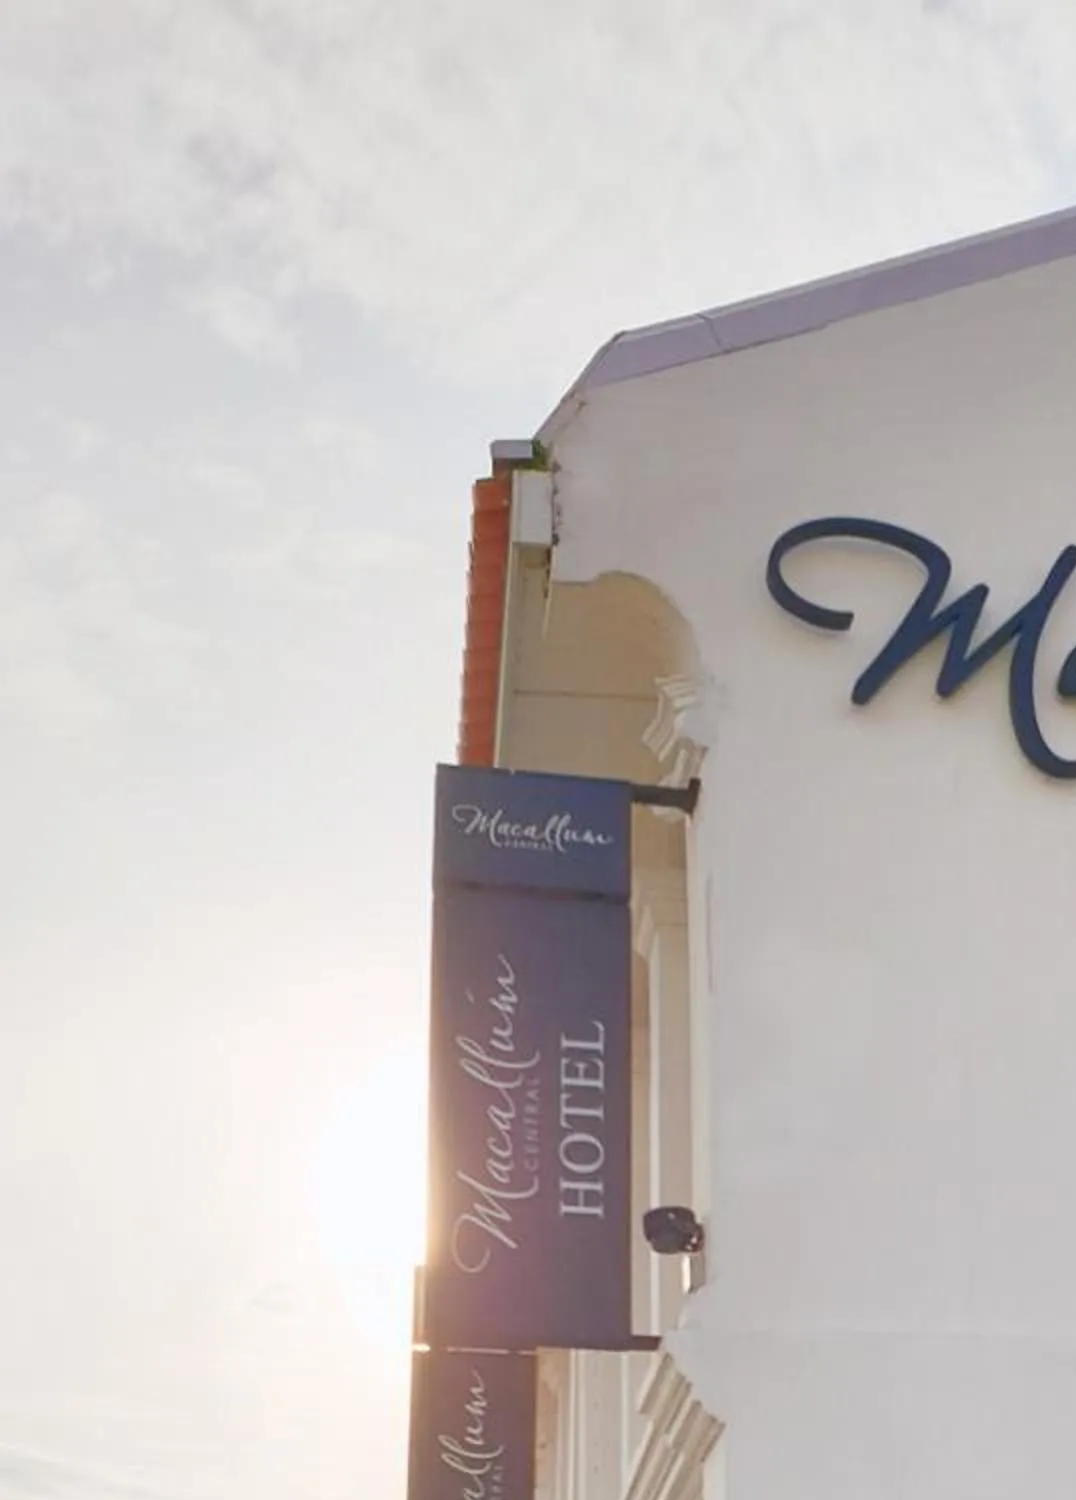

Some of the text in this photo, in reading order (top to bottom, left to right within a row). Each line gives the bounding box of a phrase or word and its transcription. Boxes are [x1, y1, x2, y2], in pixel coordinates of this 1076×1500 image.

[452, 804, 614, 852] Macallum
[451, 954, 541, 1273] Macallum
[524, 1077, 541, 1173] CENTRAL
[559, 1020, 605, 1217] HOTEL
